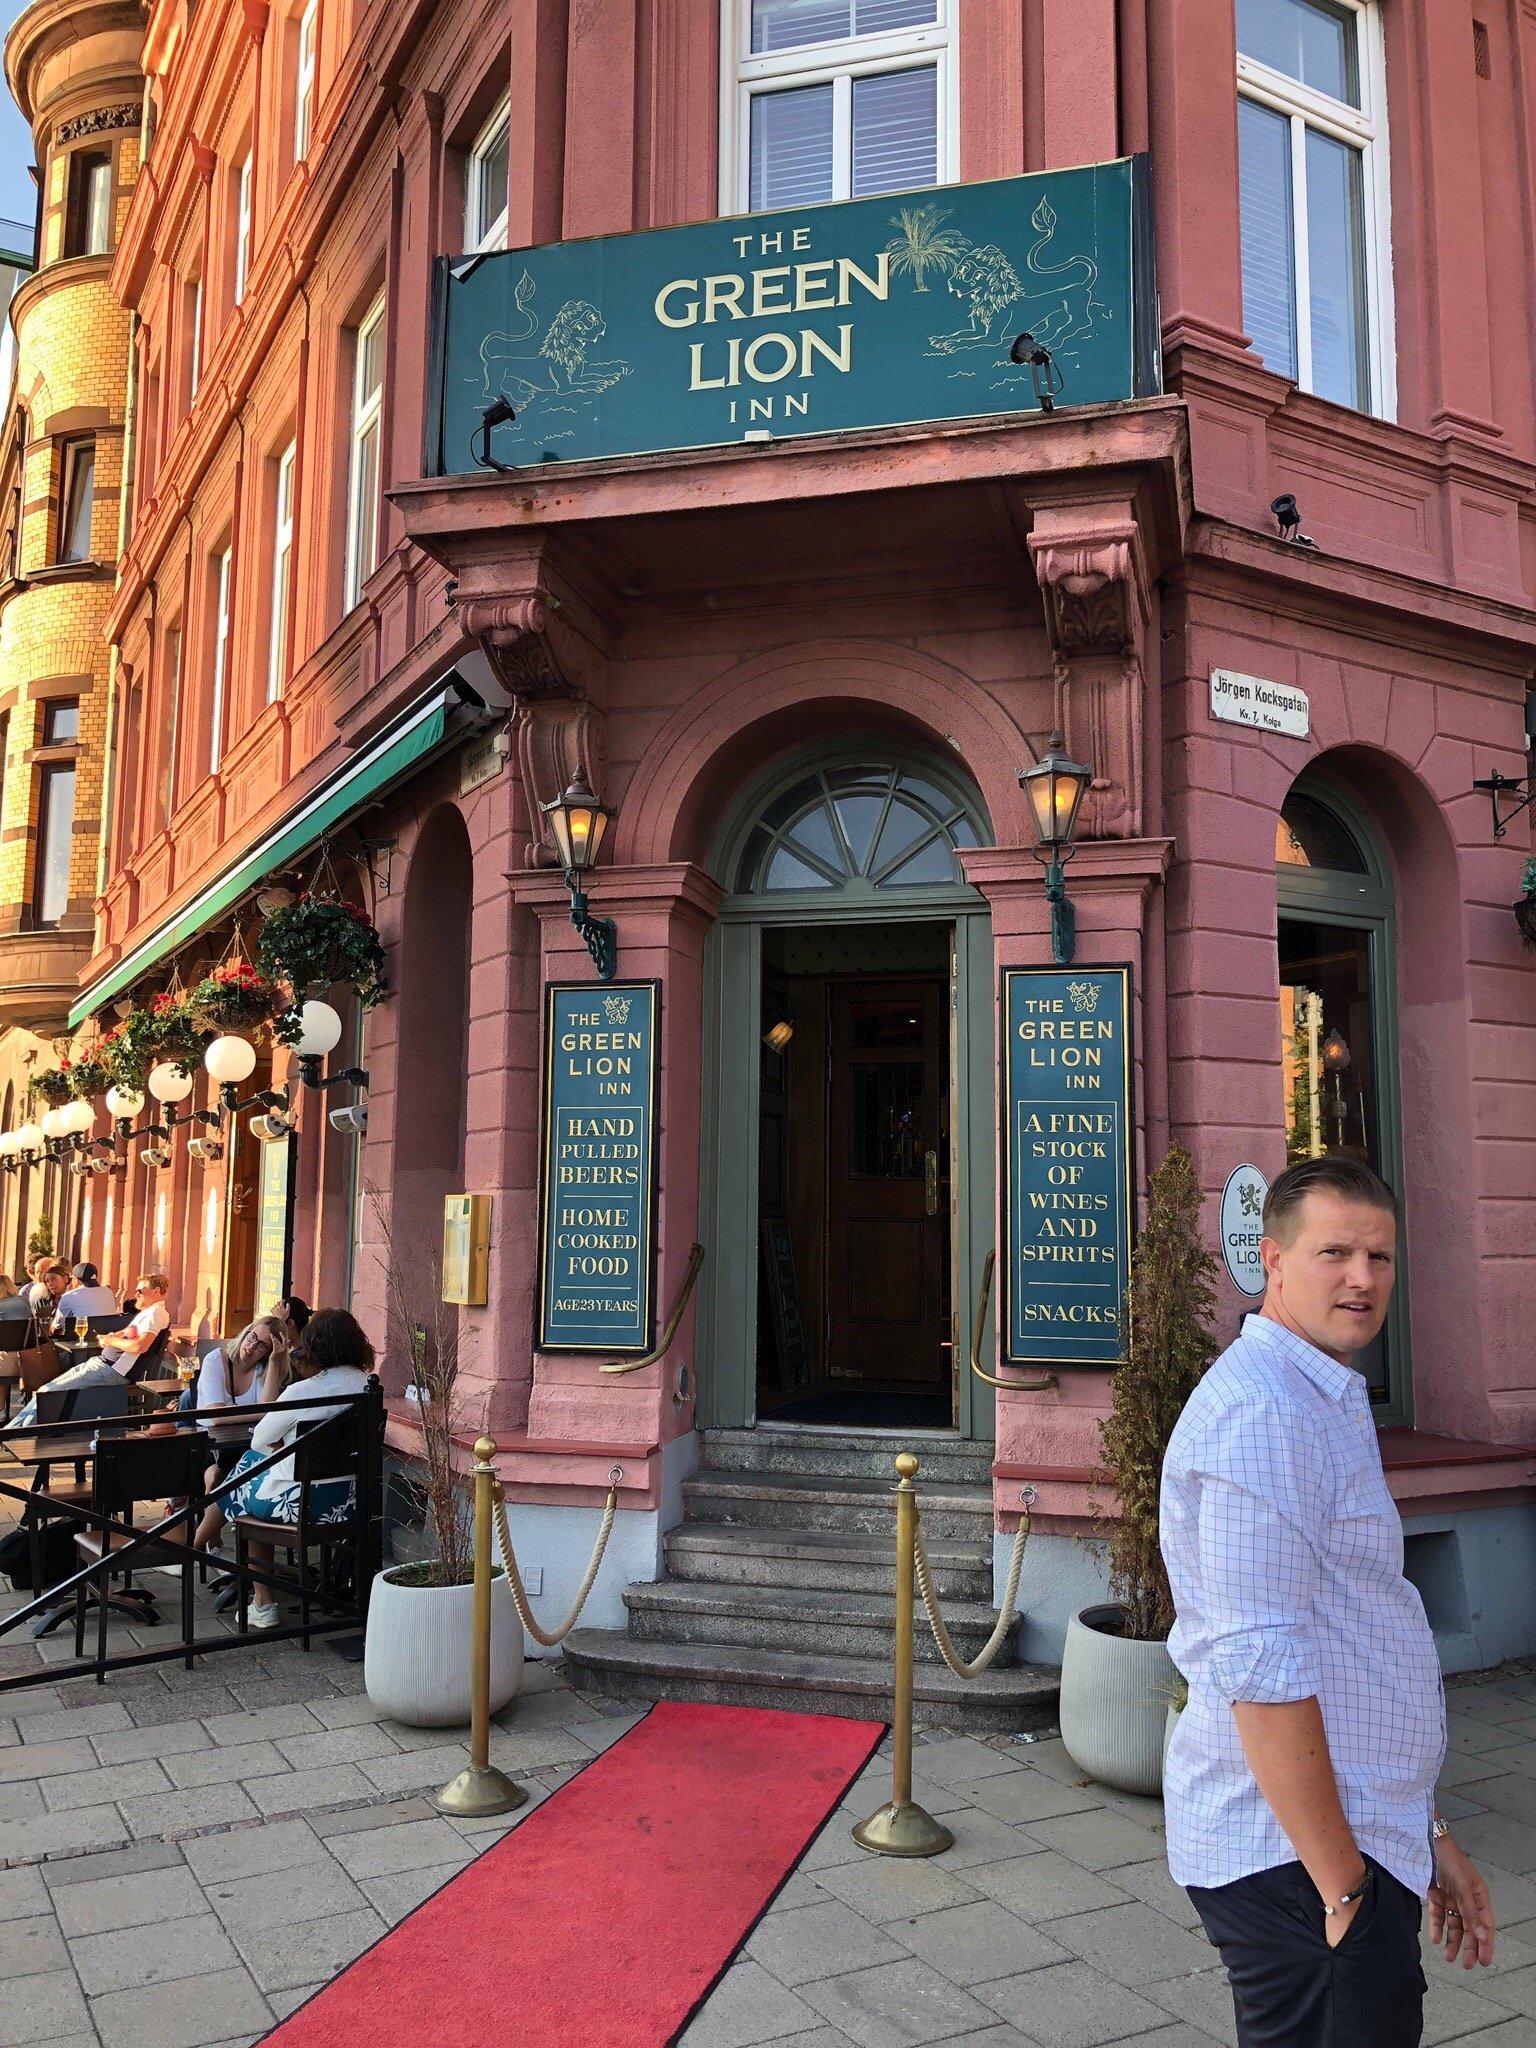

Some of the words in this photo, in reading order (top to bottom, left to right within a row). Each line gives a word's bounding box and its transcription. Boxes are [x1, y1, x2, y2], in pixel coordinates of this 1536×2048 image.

[733, 227, 811, 258] THE
[654, 252, 892, 328] GREEN
[687, 324, 854, 391] LION
[729, 393, 809, 423] INN
[1214, 676, 1251, 699] Jörgen
[1255, 685, 1308, 714] Kocksgatan
[1025, 1000, 1064, 1013] THE
[568, 1013, 600, 1026] THE
[1018, 1020, 1113, 1040] GREEN
[561, 1032, 642, 1051] GREEN
[569, 1057, 631, 1076] LION
[1030, 1047, 1101, 1067] LION
[599, 1082, 631, 1095] INN
[1066, 1075, 1100, 1089] INN
[567, 1118, 635, 1137] HAND
[1023, 1113, 1044, 1133] A
[1049, 1114, 1113, 1134] FINE
[561, 1144, 639, 1159] PULLED
[1032, 1141, 1107, 1158] STOCK
[558, 1166, 639, 1185] BEERS
[1047, 1165, 1084, 1185] OF
[1027, 1192, 1109, 1211] WINES
[561, 1208, 629, 1227] HOME
[1036, 1217, 1097, 1238] AND
[557, 1234, 637, 1250] COOKED
[1228, 1233, 1262, 1247] GREE
[1022, 1244, 1115, 1264] SPIRITS
[568, 1256, 629, 1276] FOOD
[1024, 1303, 1117, 1324] SNACKS
